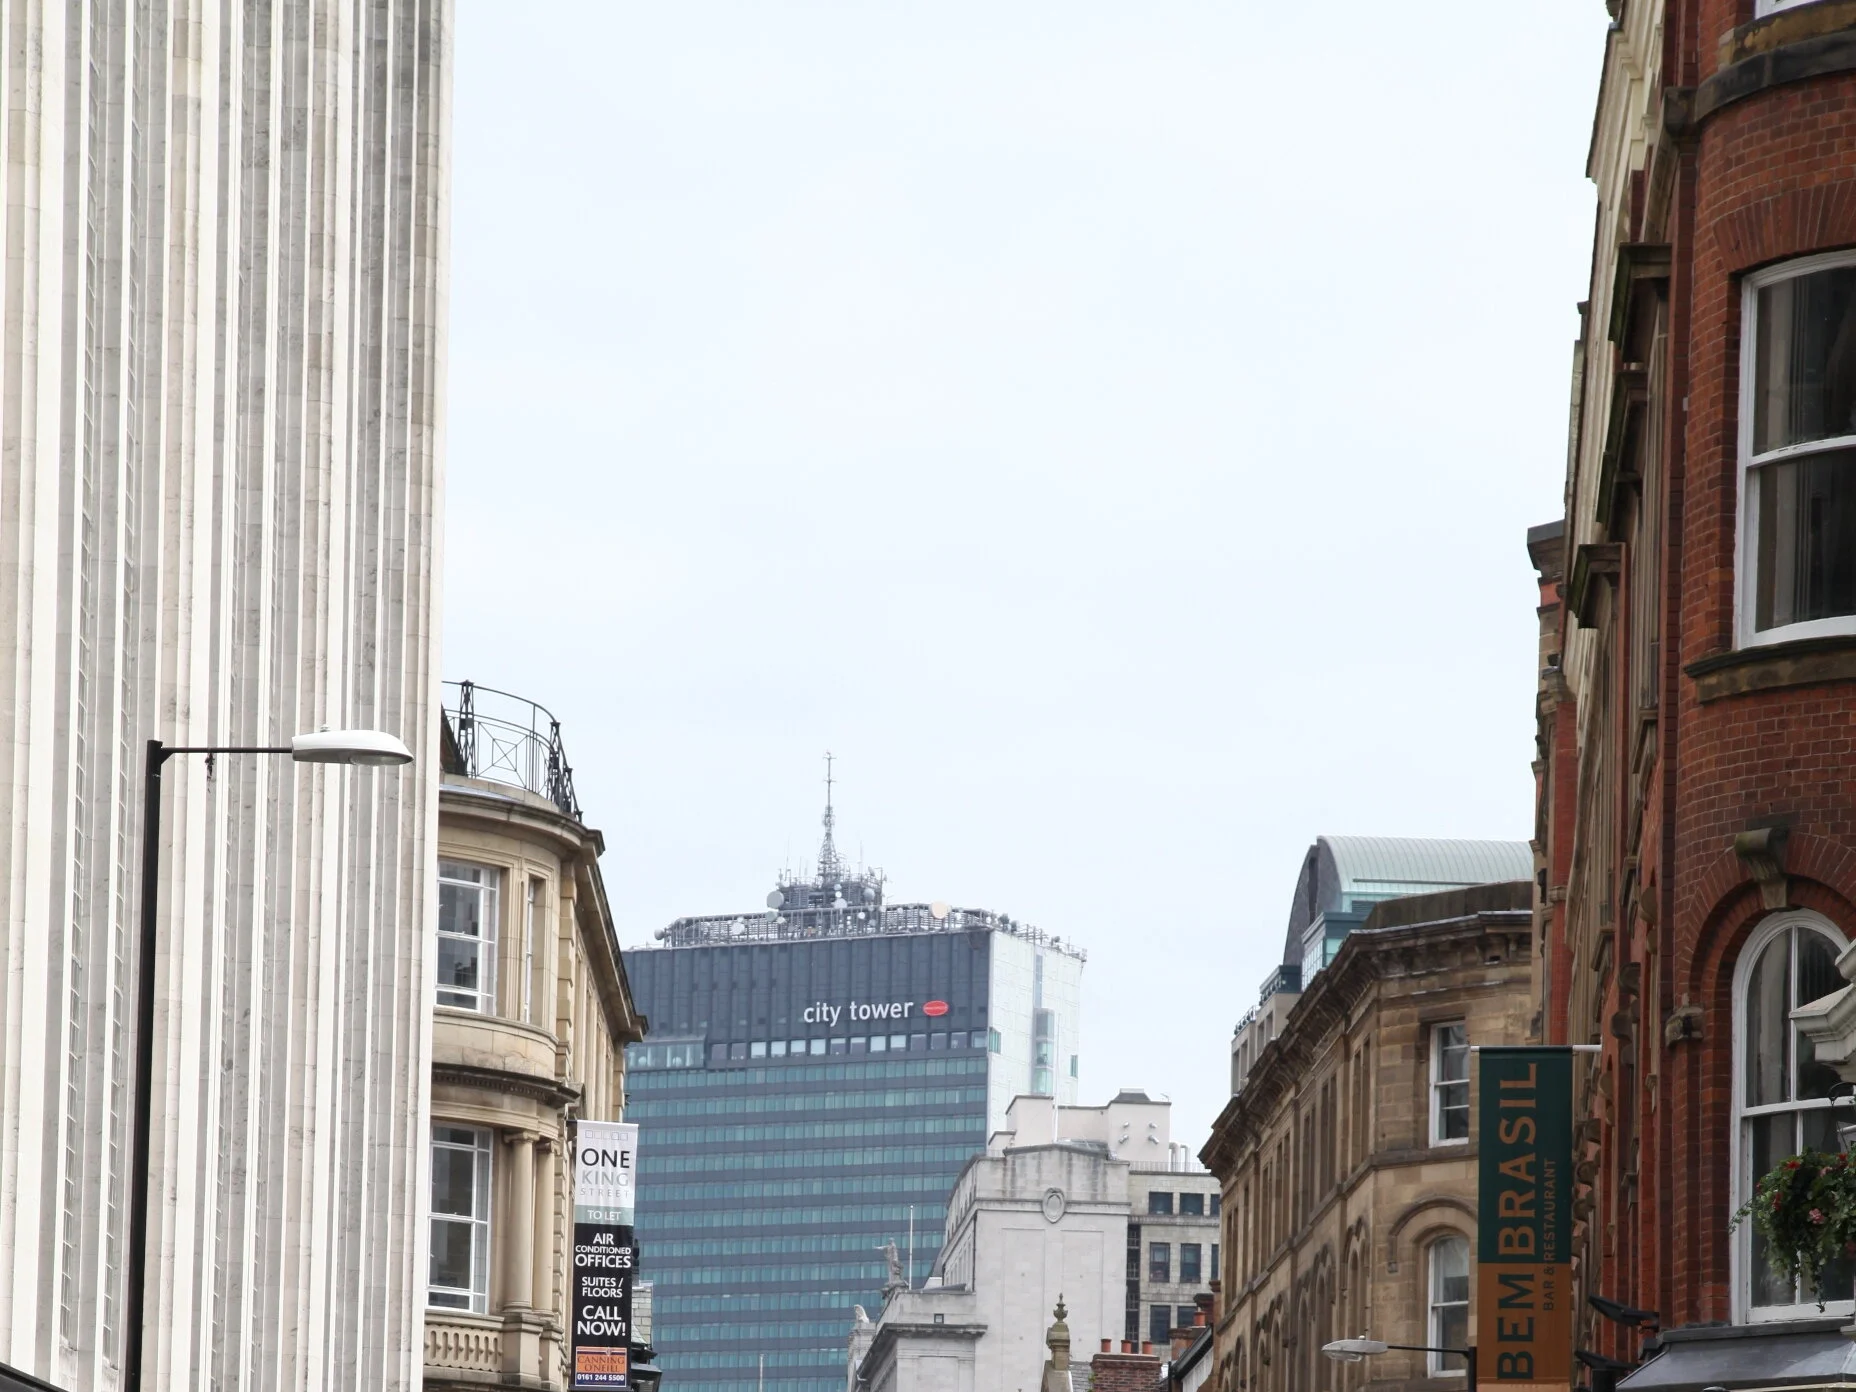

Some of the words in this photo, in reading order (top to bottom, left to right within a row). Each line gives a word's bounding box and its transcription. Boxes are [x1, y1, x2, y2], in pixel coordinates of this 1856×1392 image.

[803, 1001, 841, 1027] city
[850, 1001, 914, 1021] tower
[581, 1147, 630, 1168] ONE
[1498, 1063, 1537, 1256] BRASIL
[581, 1170, 629, 1187] KING
[580, 1187, 630, 1198] STREET
[587, 1209, 602, 1220] TO
[604, 1211, 622, 1222] LET
[1544, 1157, 1557, 1263] RESTAURANT
[593, 1232, 614, 1245] AIR
[575, 1245, 632, 1255] CONDITIONED
[575, 1253, 632, 1269] OFFICES
[1544, 1265, 1556, 1276] &
[582, 1276, 616, 1288] SUITES
[618, 1277, 624, 1288] /
[582, 1287, 623, 1298] FLOORS
[1543, 1280, 1555, 1311] BAR
[582, 1305, 622, 1320] CALL
[577, 1320, 626, 1337] NOW!
[1497, 1273, 1534, 1380] BEM
[577, 1355, 625, 1365] CANNING
[577, 1373, 593, 1381] 0161
[608, 1374, 625, 1382] 5500
